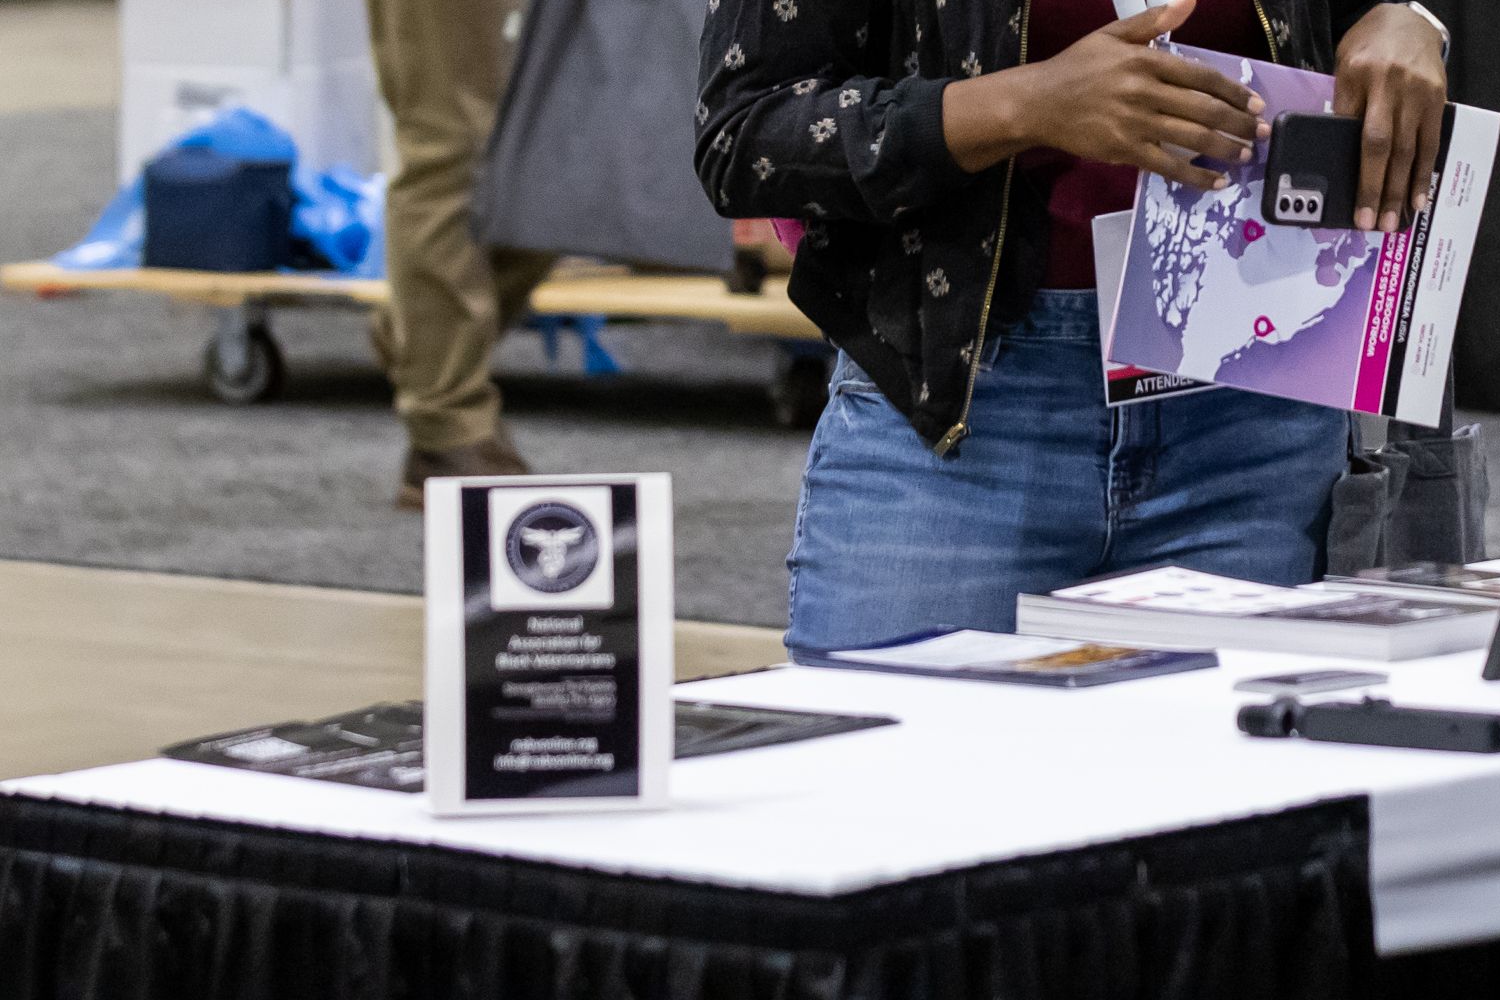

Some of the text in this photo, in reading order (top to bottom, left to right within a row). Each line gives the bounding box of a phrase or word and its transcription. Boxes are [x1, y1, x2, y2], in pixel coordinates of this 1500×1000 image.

[1379, 296, 1395, 343] CHOOSE
[1388, 264, 1400, 295] YOUR
[1397, 318, 1409, 343] VISIT
[1416, 232, 1426, 247] TO
